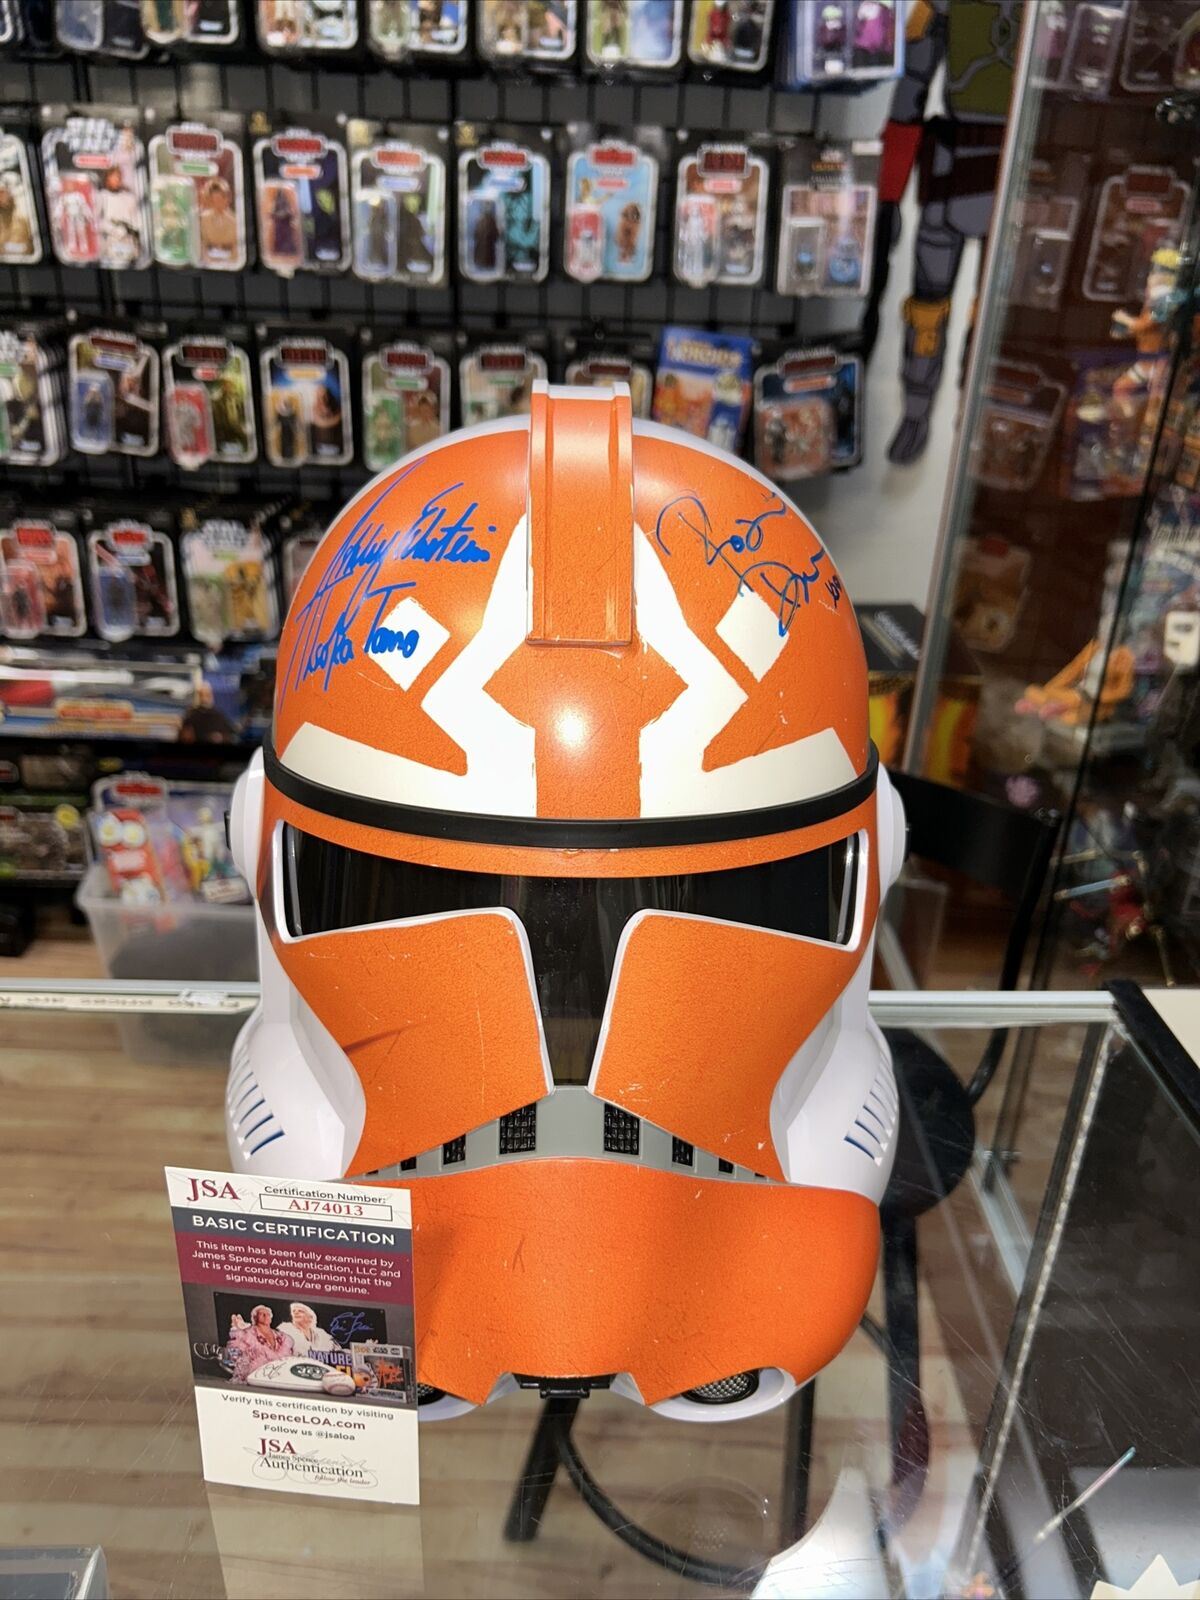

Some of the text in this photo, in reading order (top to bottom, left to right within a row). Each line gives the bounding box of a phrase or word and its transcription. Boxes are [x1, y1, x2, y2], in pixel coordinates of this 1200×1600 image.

[186, 1177, 241, 1202] JSA
[264, 1186, 386, 1204] Certification Number:
[288, 1199, 364, 1216] AJ74013
[192, 1215, 395, 1246] BASIC CERTIFICATION
[192, 1250, 401, 1278] James Spence Authentication, LLC and
[196, 1240, 394, 1269] This item has been fully examined by
[212, 1262, 221, 1270] is
[224, 1264, 242, 1272] our
[244, 1266, 303, 1278] considered
[306, 1272, 347, 1283] opinion
[349, 1276, 371, 1285] that
[374, 1278, 392, 1288] the
[225, 1273, 370, 1295] signature(s) is/are genuine.
[308, 1349, 352, 1366] NATURE
[221, 1394, 394, 1420] Verify this certification by visiting
[252, 1410, 366, 1430] SpenceLOA.com
[264, 1424, 298, 1434] Follow
[316, 1430, 356, 1441] @jsaloa
[257, 1438, 296, 1456] JSA
[267, 1452, 290, 1460] James
[259, 1456, 364, 1478] Authentication
